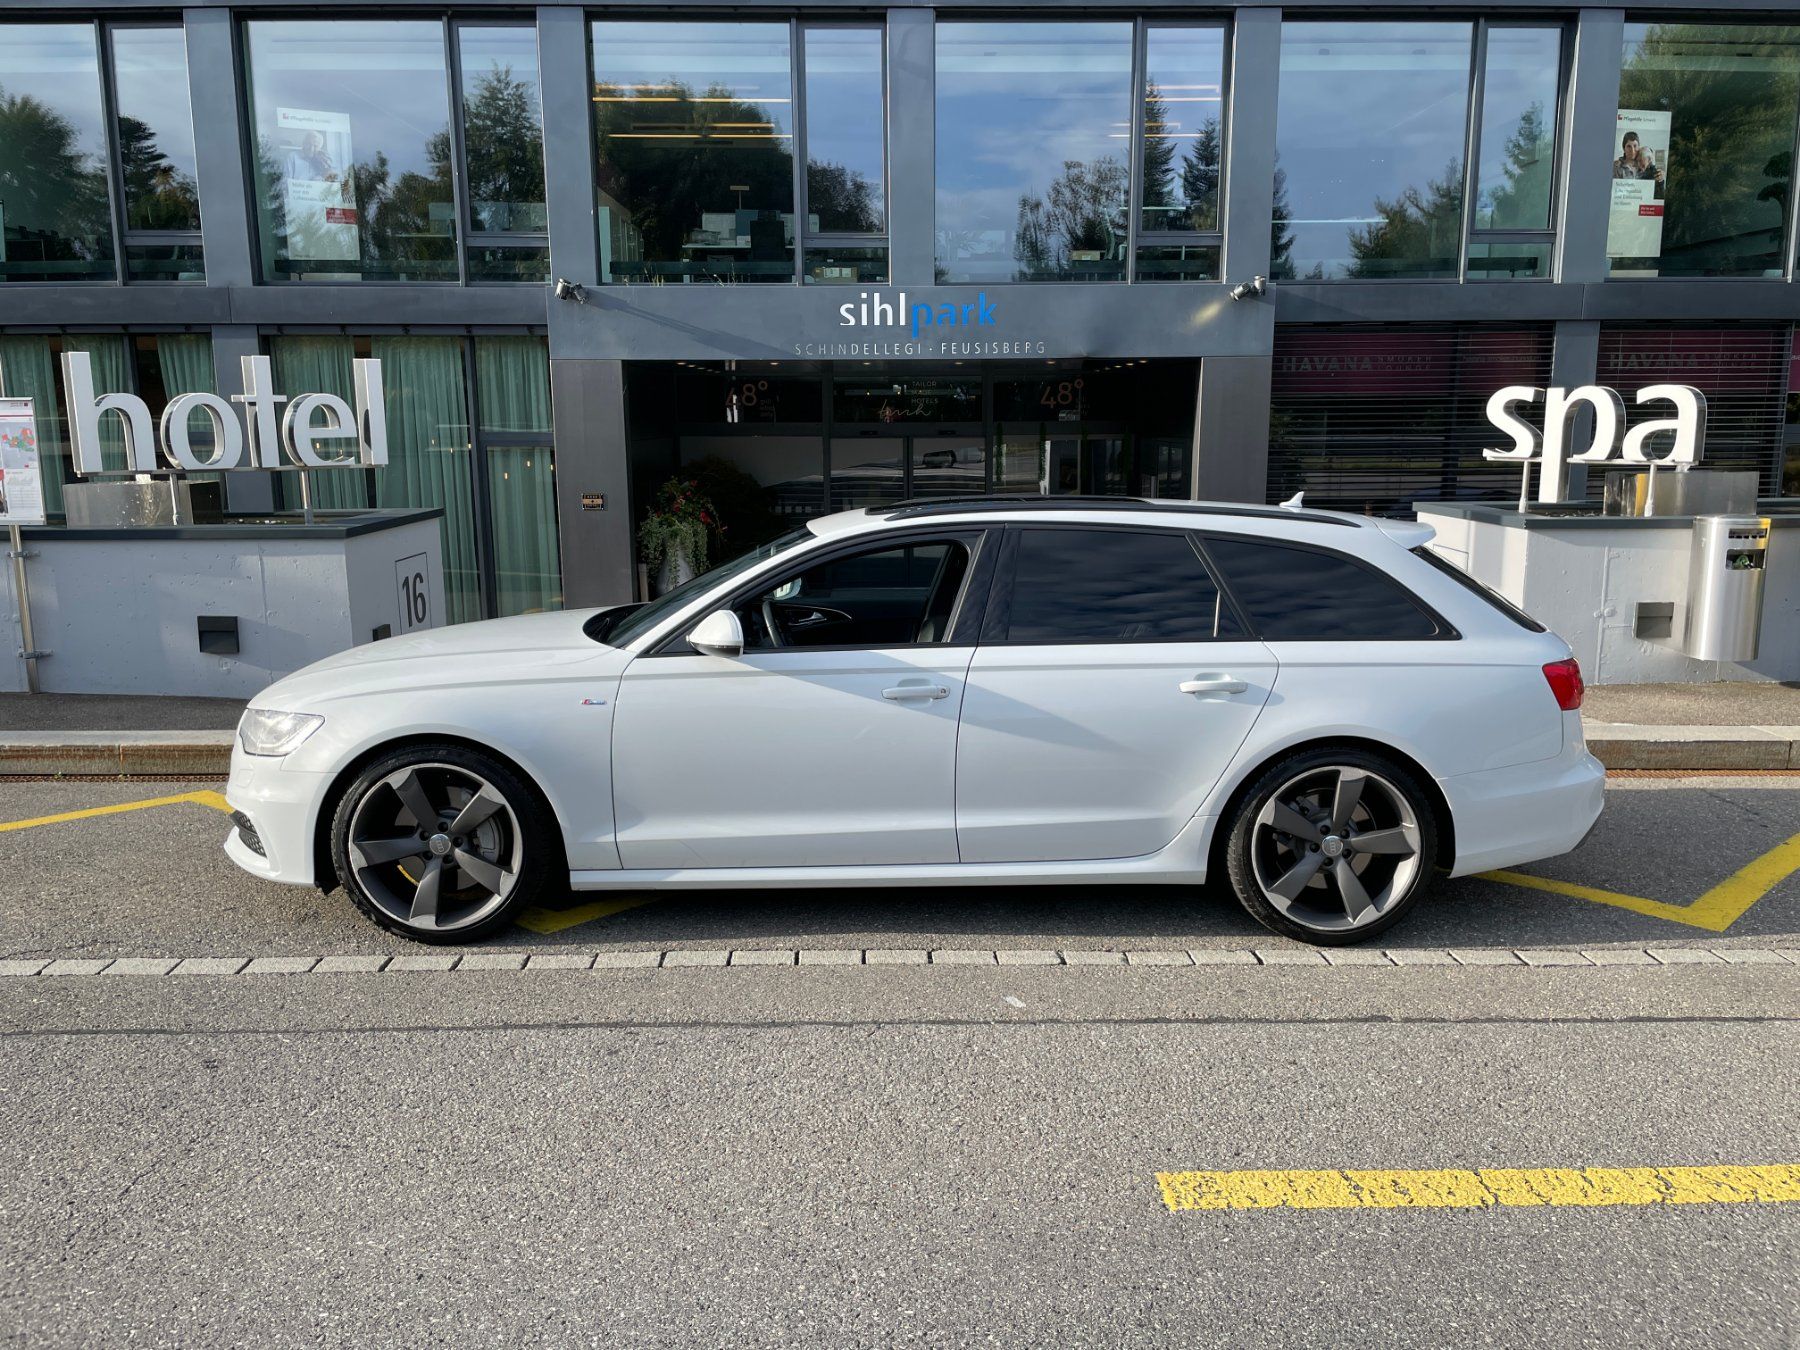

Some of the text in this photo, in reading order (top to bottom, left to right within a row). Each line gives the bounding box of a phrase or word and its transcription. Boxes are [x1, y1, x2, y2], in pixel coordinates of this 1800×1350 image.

[839, 292, 997, 339] sihlpark
[795, 342, 1046, 356] SCHINDELLEGI FEUSISBERG
[1282, 356, 1373, 371] HAVANA
[1609, 352, 1698, 368] HAVANA
[61, 352, 389, 477] hotel
[911, 397, 938, 405] HOTELS
[1483, 384, 1707, 503] spa
[402, 572, 427, 629] 16
